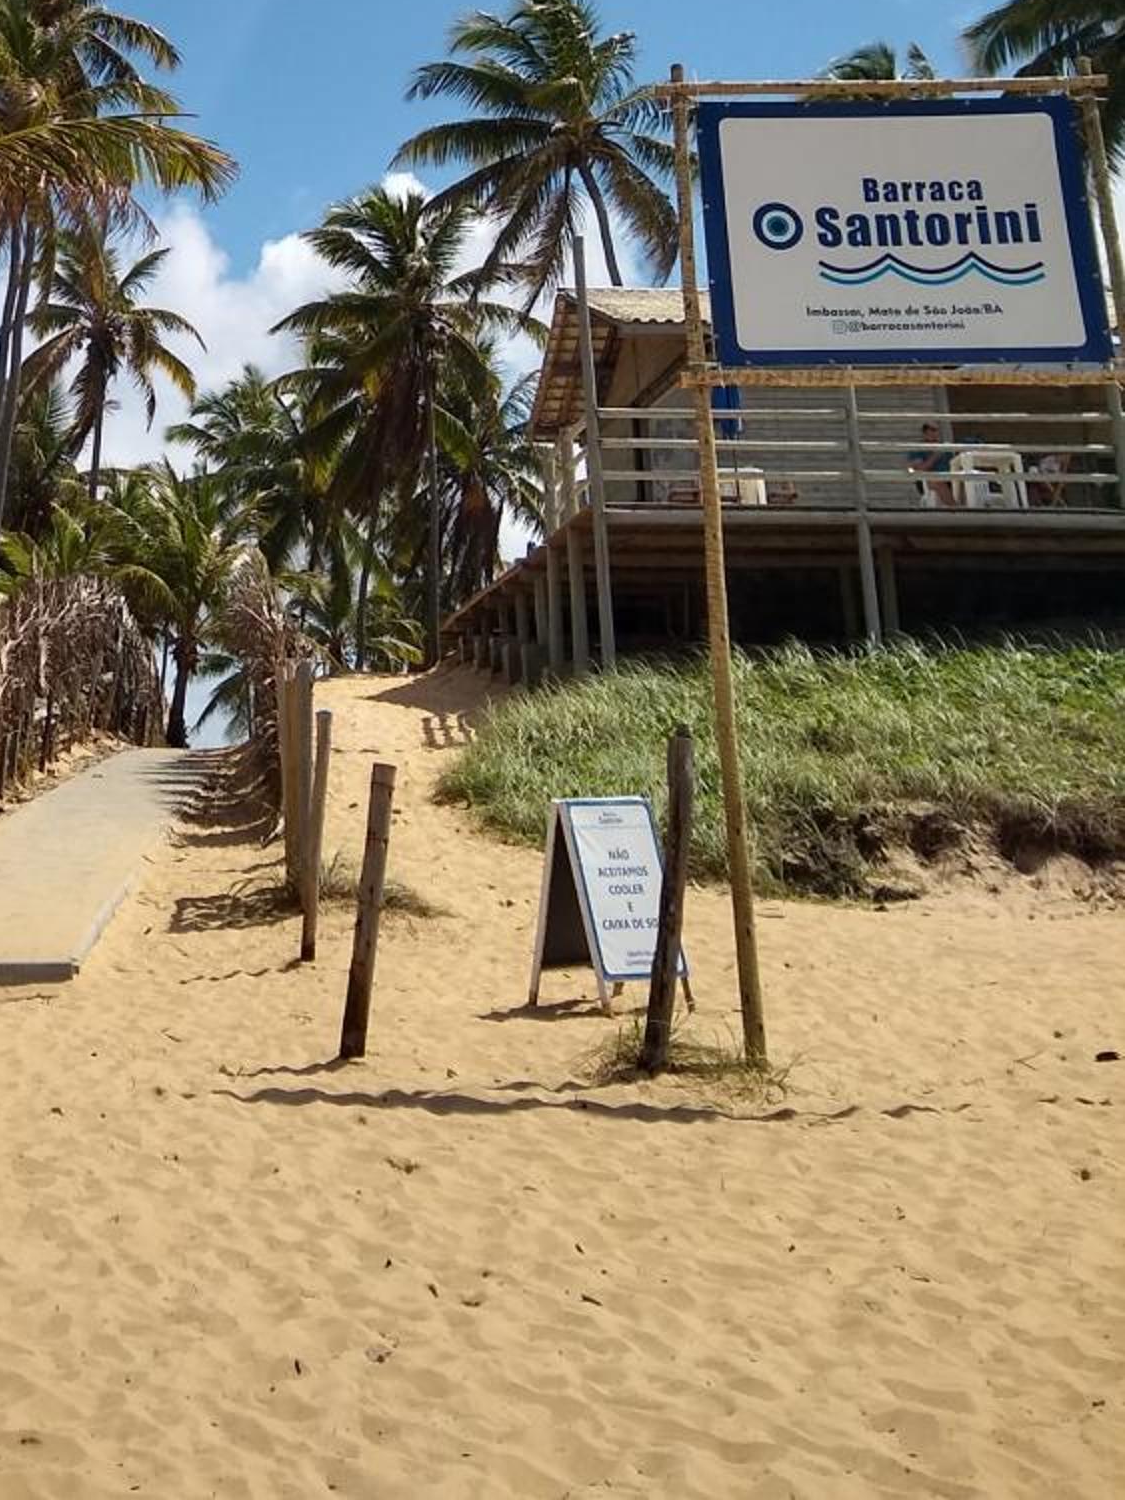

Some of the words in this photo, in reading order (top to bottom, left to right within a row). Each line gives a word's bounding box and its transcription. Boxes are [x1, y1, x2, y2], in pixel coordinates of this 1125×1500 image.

[862, 178, 984, 202] Barraca
[815, 203, 1043, 247] Santorini
[904, 304, 920, 316] de
[923, 303, 948, 316] São
[608, 847, 630, 861] NÃO
[598, 865, 649, 878] ACEITAMOS
[608, 883, 644, 895] COOLER
[627, 901, 635, 913] E
[602, 918, 631, 931] CAIXA
[646, 917, 659, 929] SO
